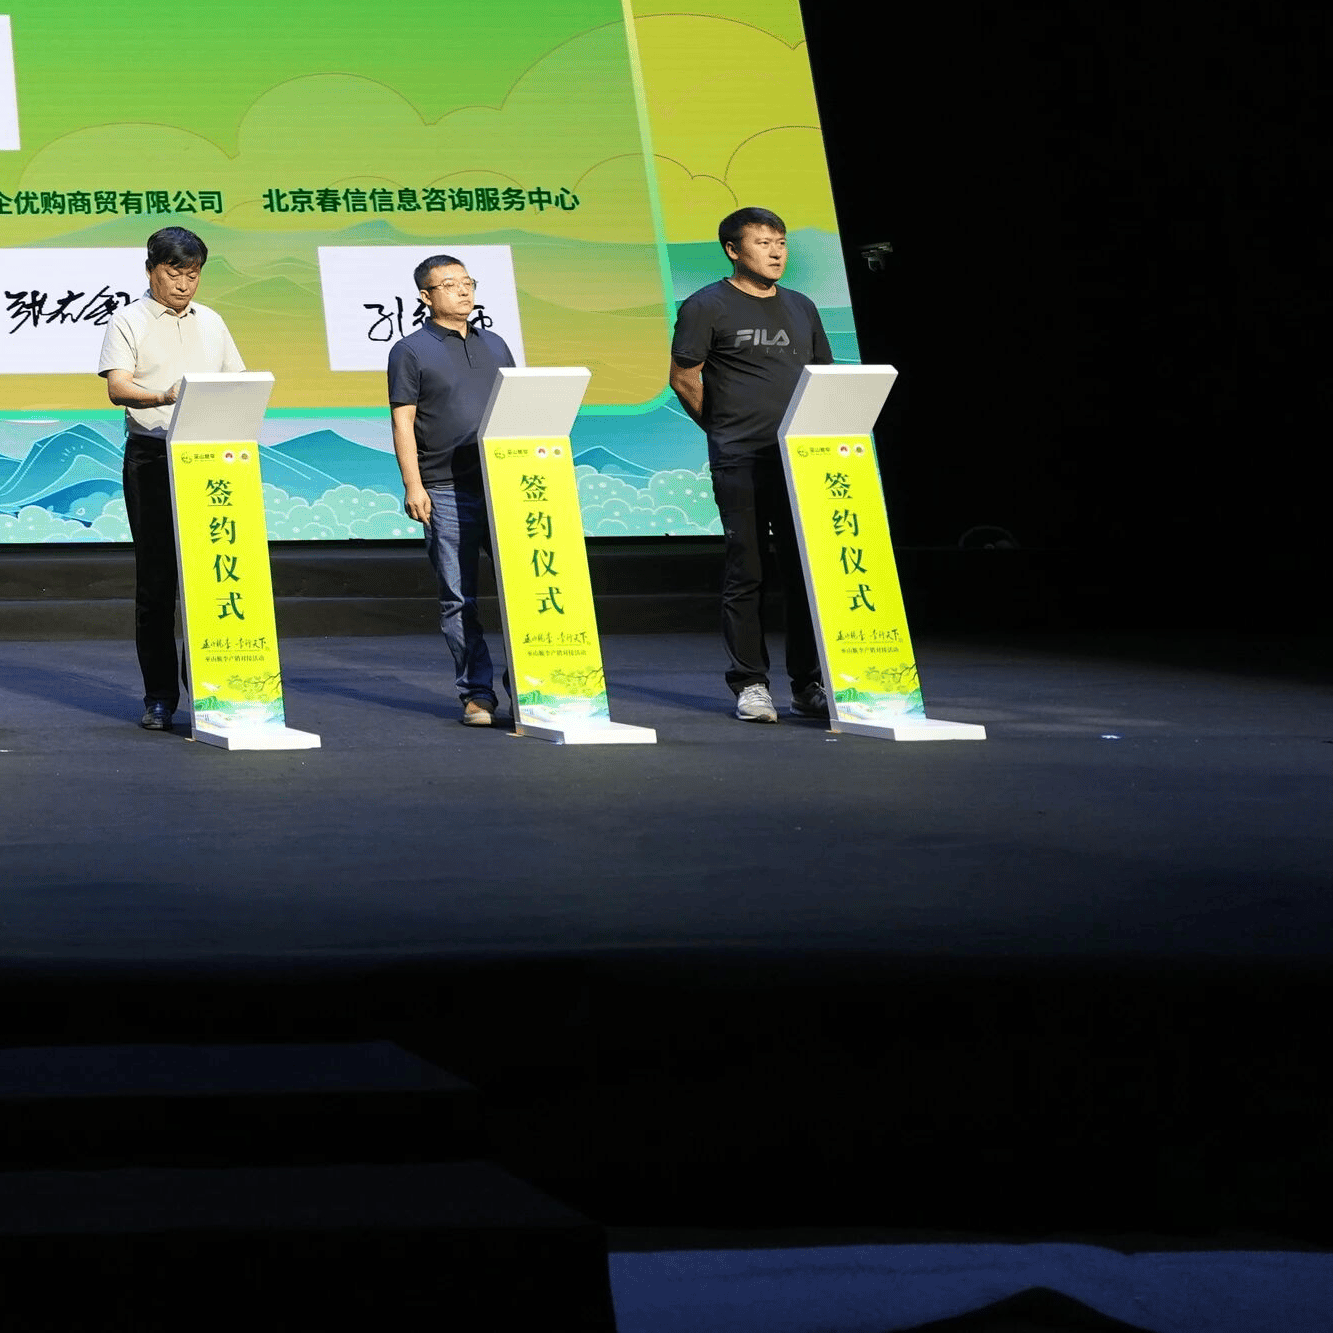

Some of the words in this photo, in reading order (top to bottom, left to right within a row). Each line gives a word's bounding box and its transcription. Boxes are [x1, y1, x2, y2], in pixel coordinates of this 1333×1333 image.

[262, 186, 580, 213] 北京春信信息咨询服务中心
[733, 328, 791, 348] FILA
[204, 478, 245, 620] 签约仪式
[519, 473, 565, 615] 签约仪式
[823, 471, 876, 612] 签约仪式
